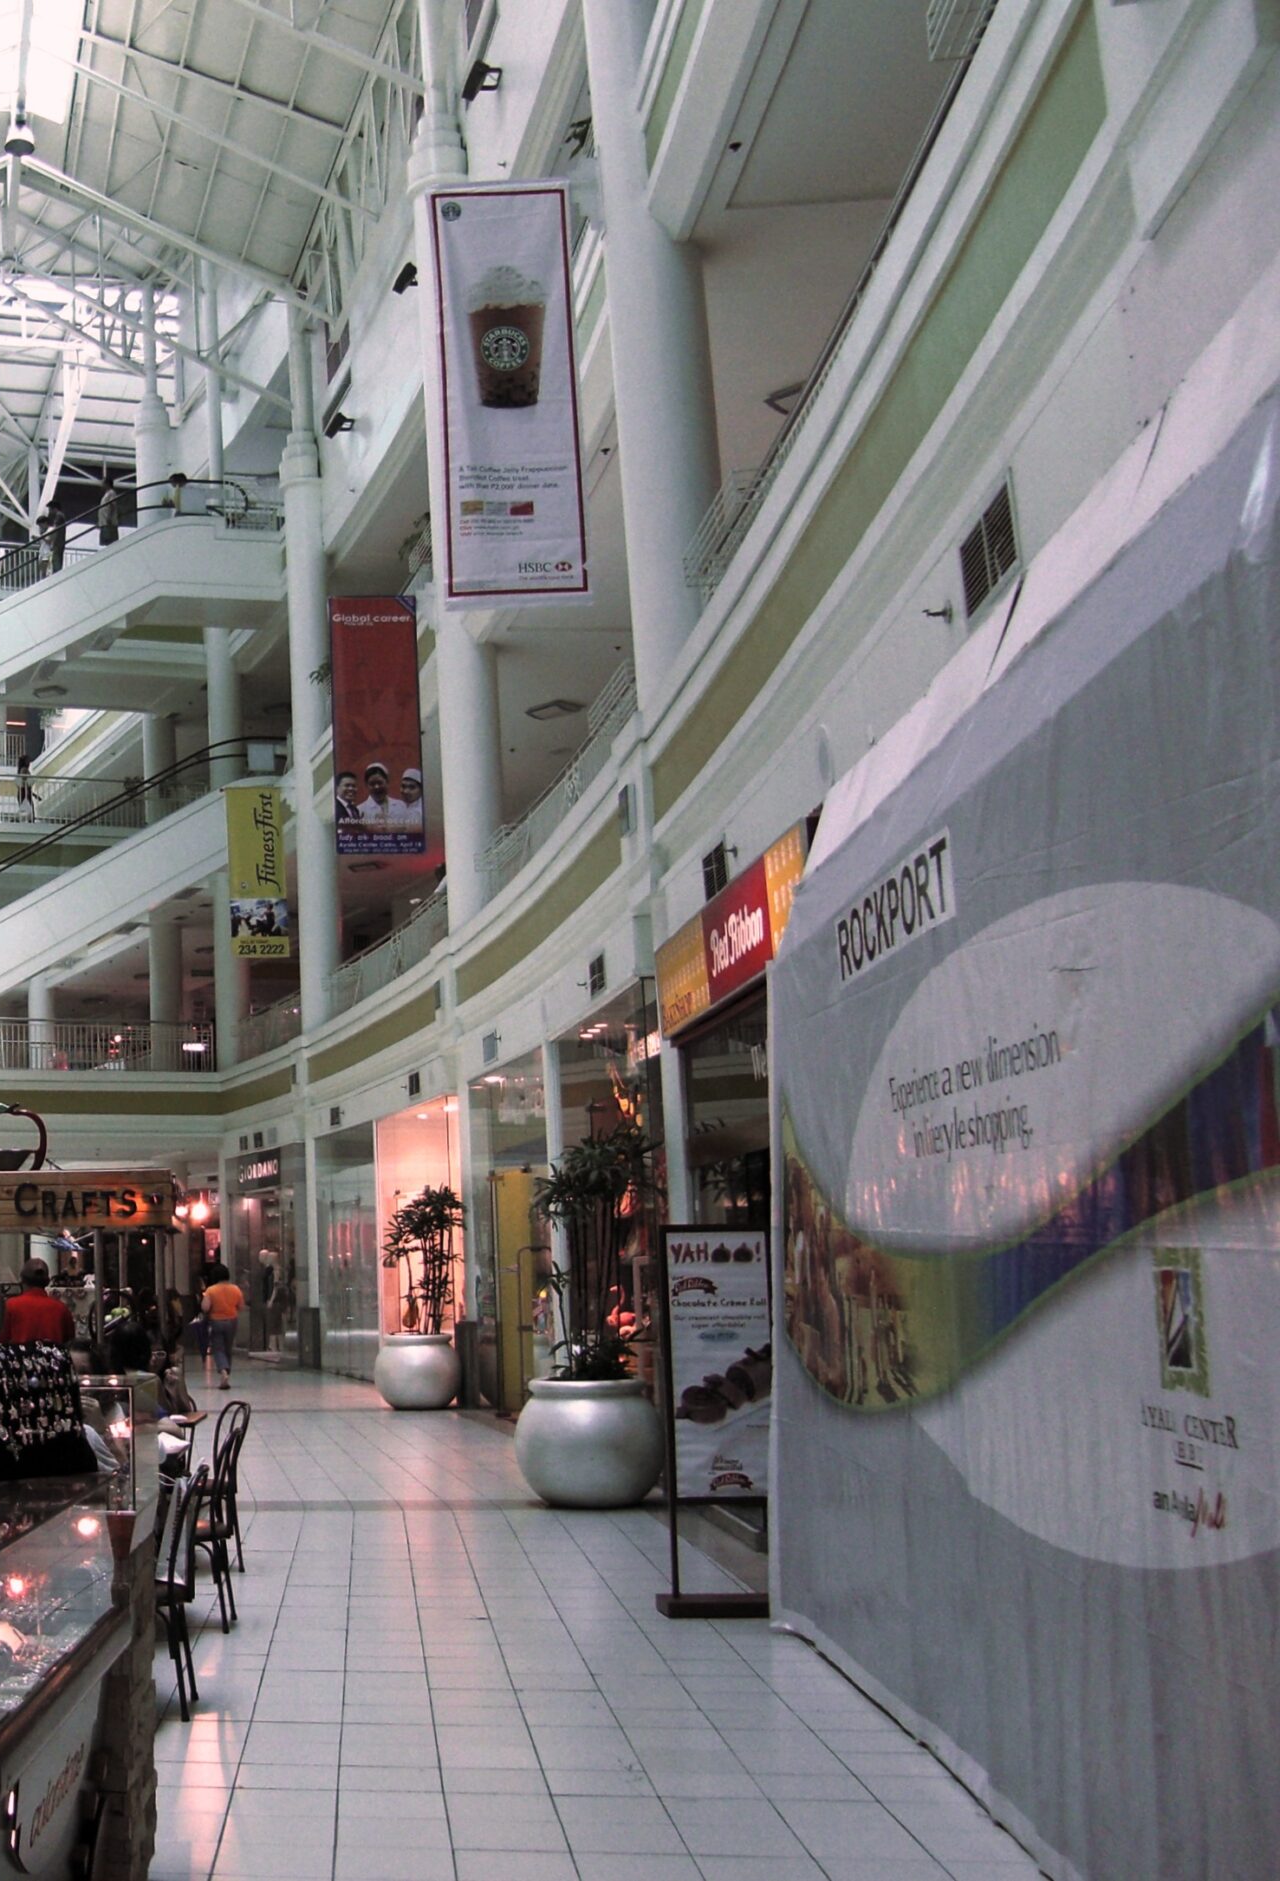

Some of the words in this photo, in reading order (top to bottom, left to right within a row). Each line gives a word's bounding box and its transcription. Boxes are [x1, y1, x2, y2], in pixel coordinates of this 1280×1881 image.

[484, 328, 526, 346] STARBUCKS
[489, 358, 521, 369] COFFEE
[518, 562, 552, 573] HSBC
[332, 613, 370, 623] Global
[838, 838, 947, 981] ROCKPORT
[239, 944, 257, 955] 234
[260, 944, 285, 955] 2222
[710, 923, 728, 977] Red
[728, 905, 764, 968] Ribbon
[942, 1066, 952, 1096] a
[986, 1022, 1061, 1083] dimension
[912, 1121, 925, 1158] in
[239, 1158, 279, 1184] GIORDANO
[671, 1299, 718, 1308] Chocolate
[750, 1297, 767, 1307] Roll
